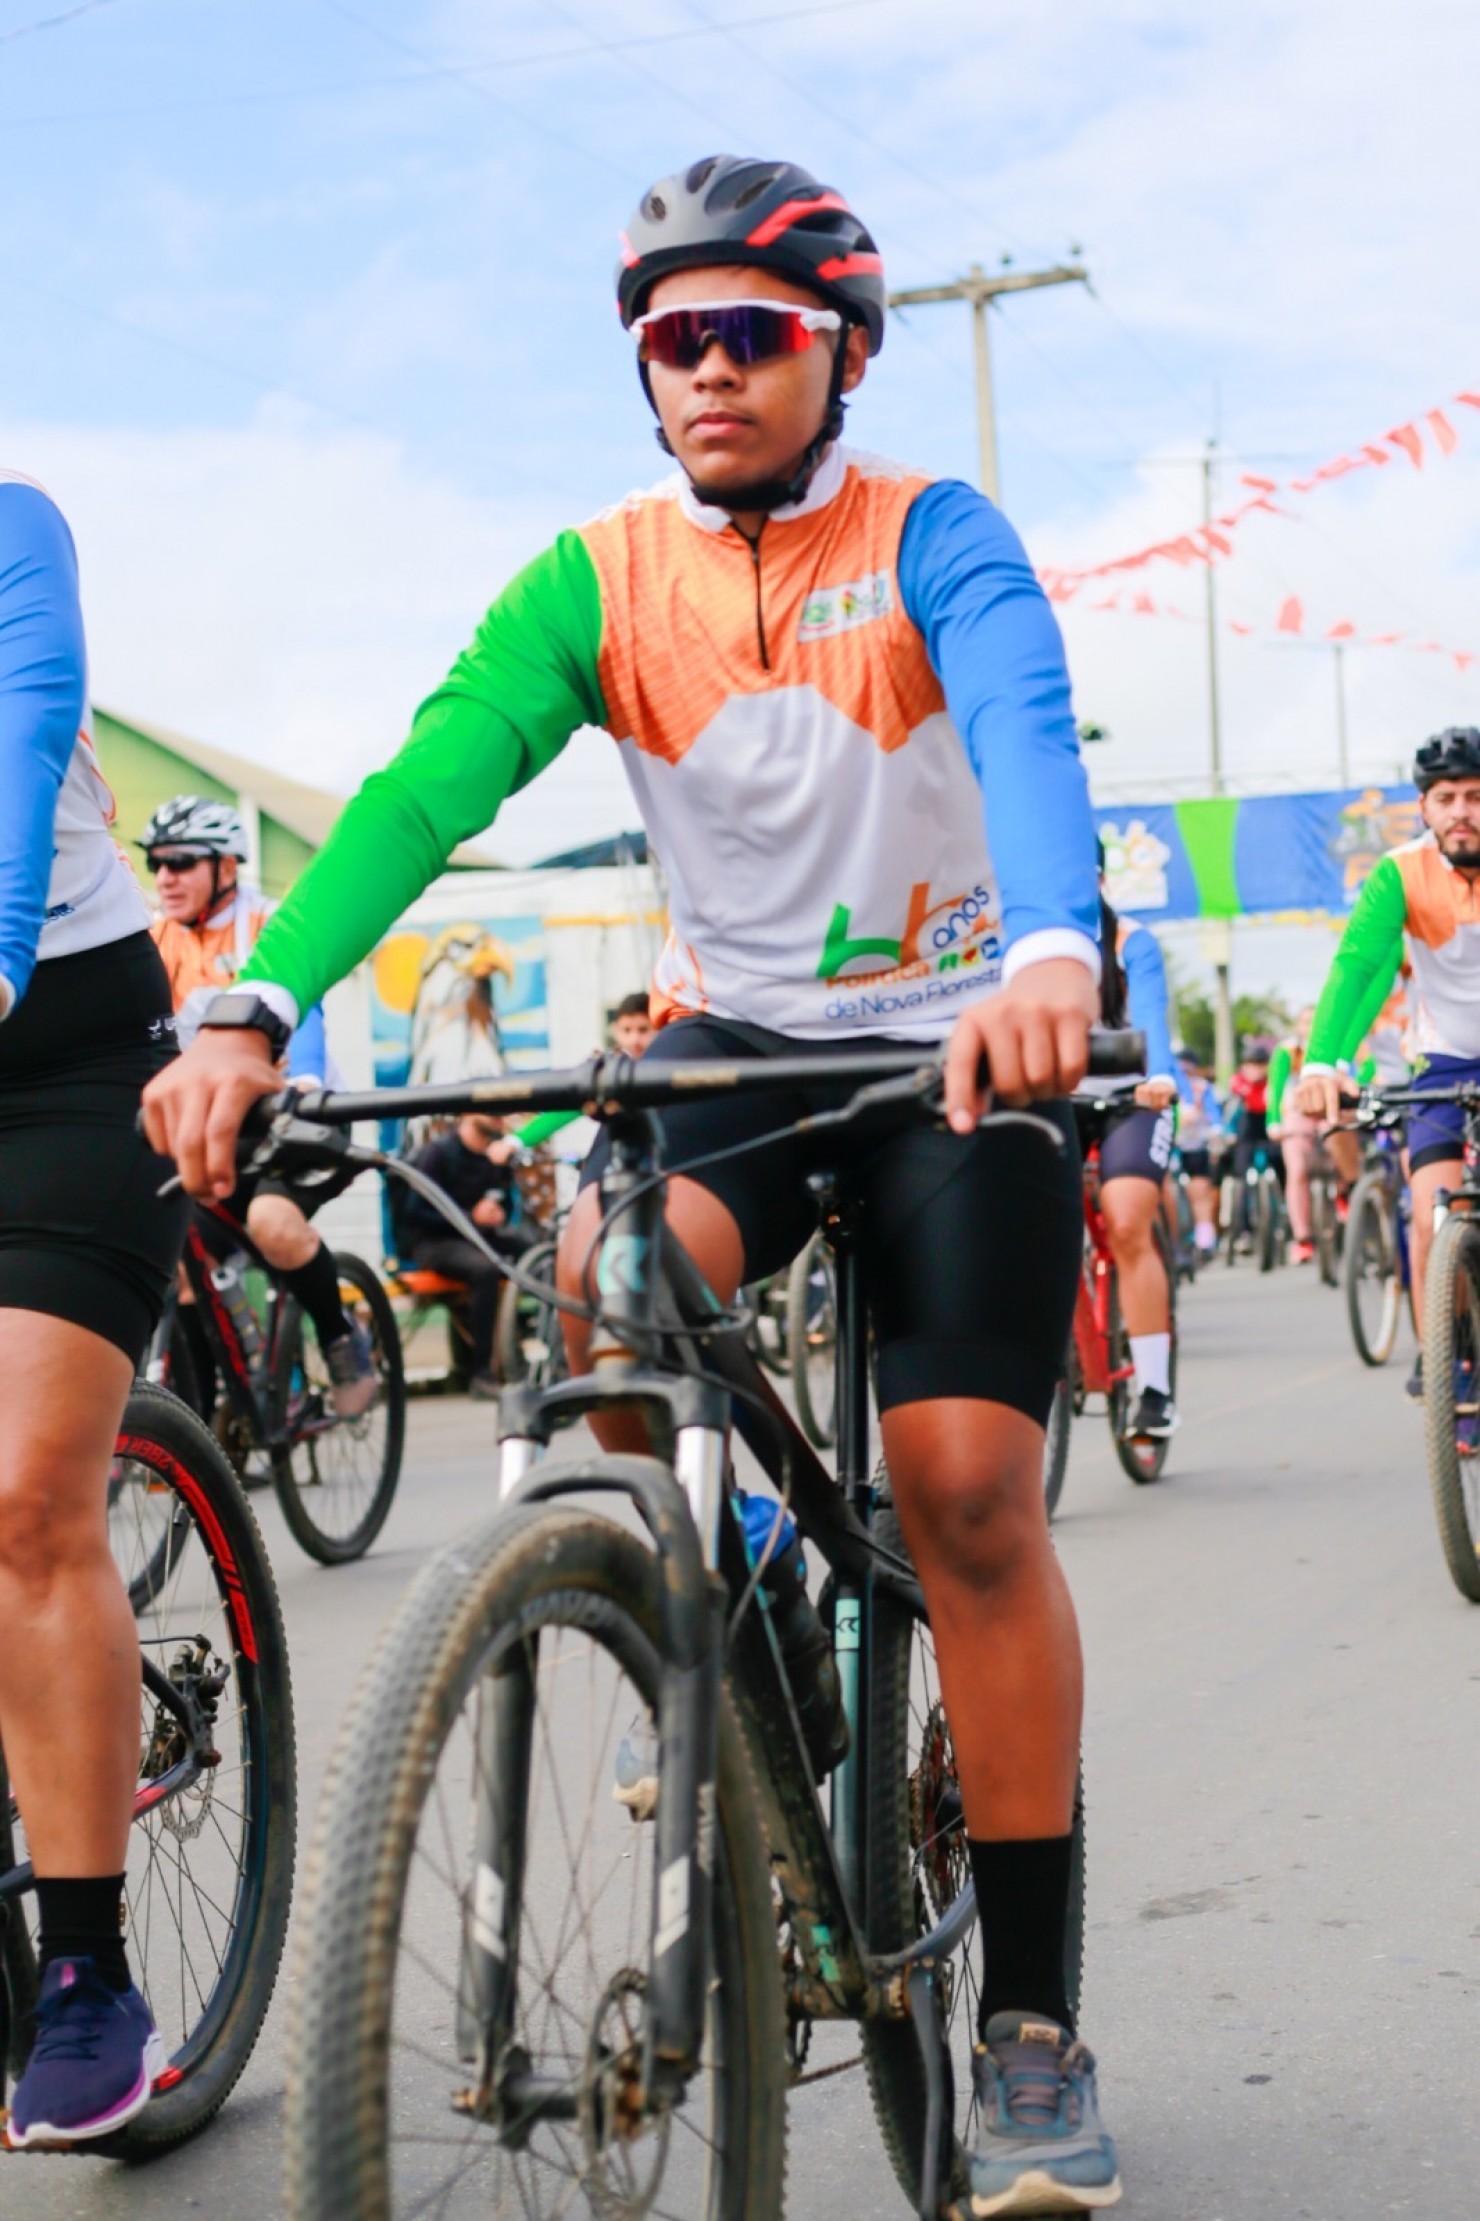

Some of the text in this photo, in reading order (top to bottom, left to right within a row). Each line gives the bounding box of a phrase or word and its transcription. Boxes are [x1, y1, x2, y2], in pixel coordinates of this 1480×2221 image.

[932, 885, 990, 949] anos
[826, 996, 858, 1020] de
[861, 992, 923, 1016] Nova
